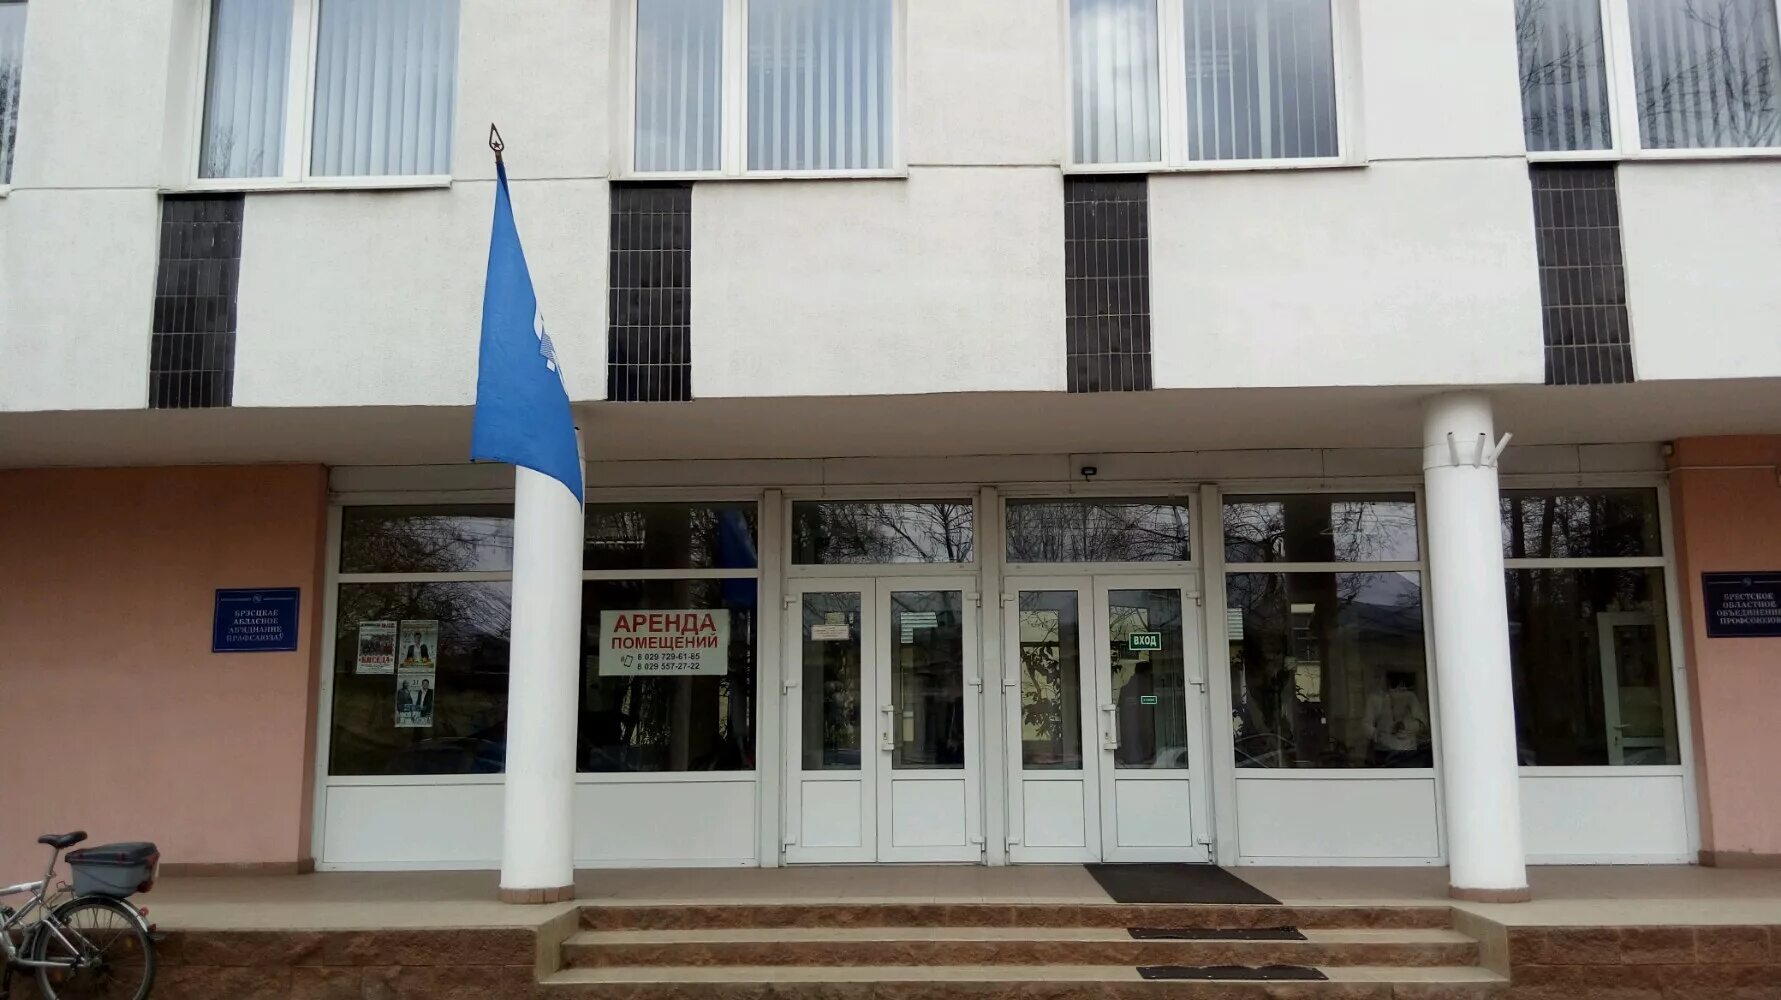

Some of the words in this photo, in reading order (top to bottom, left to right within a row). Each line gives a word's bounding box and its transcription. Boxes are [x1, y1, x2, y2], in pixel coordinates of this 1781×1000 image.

[613, 613, 717, 635] АРЕНДА
[611, 632, 718, 651] ПОМЕЩЕНИЙ
[1133, 635, 1157, 647] ВХОД
[661, 652, 700, 660] 729-61-85
[661, 662, 700, 670] 557-27-22
